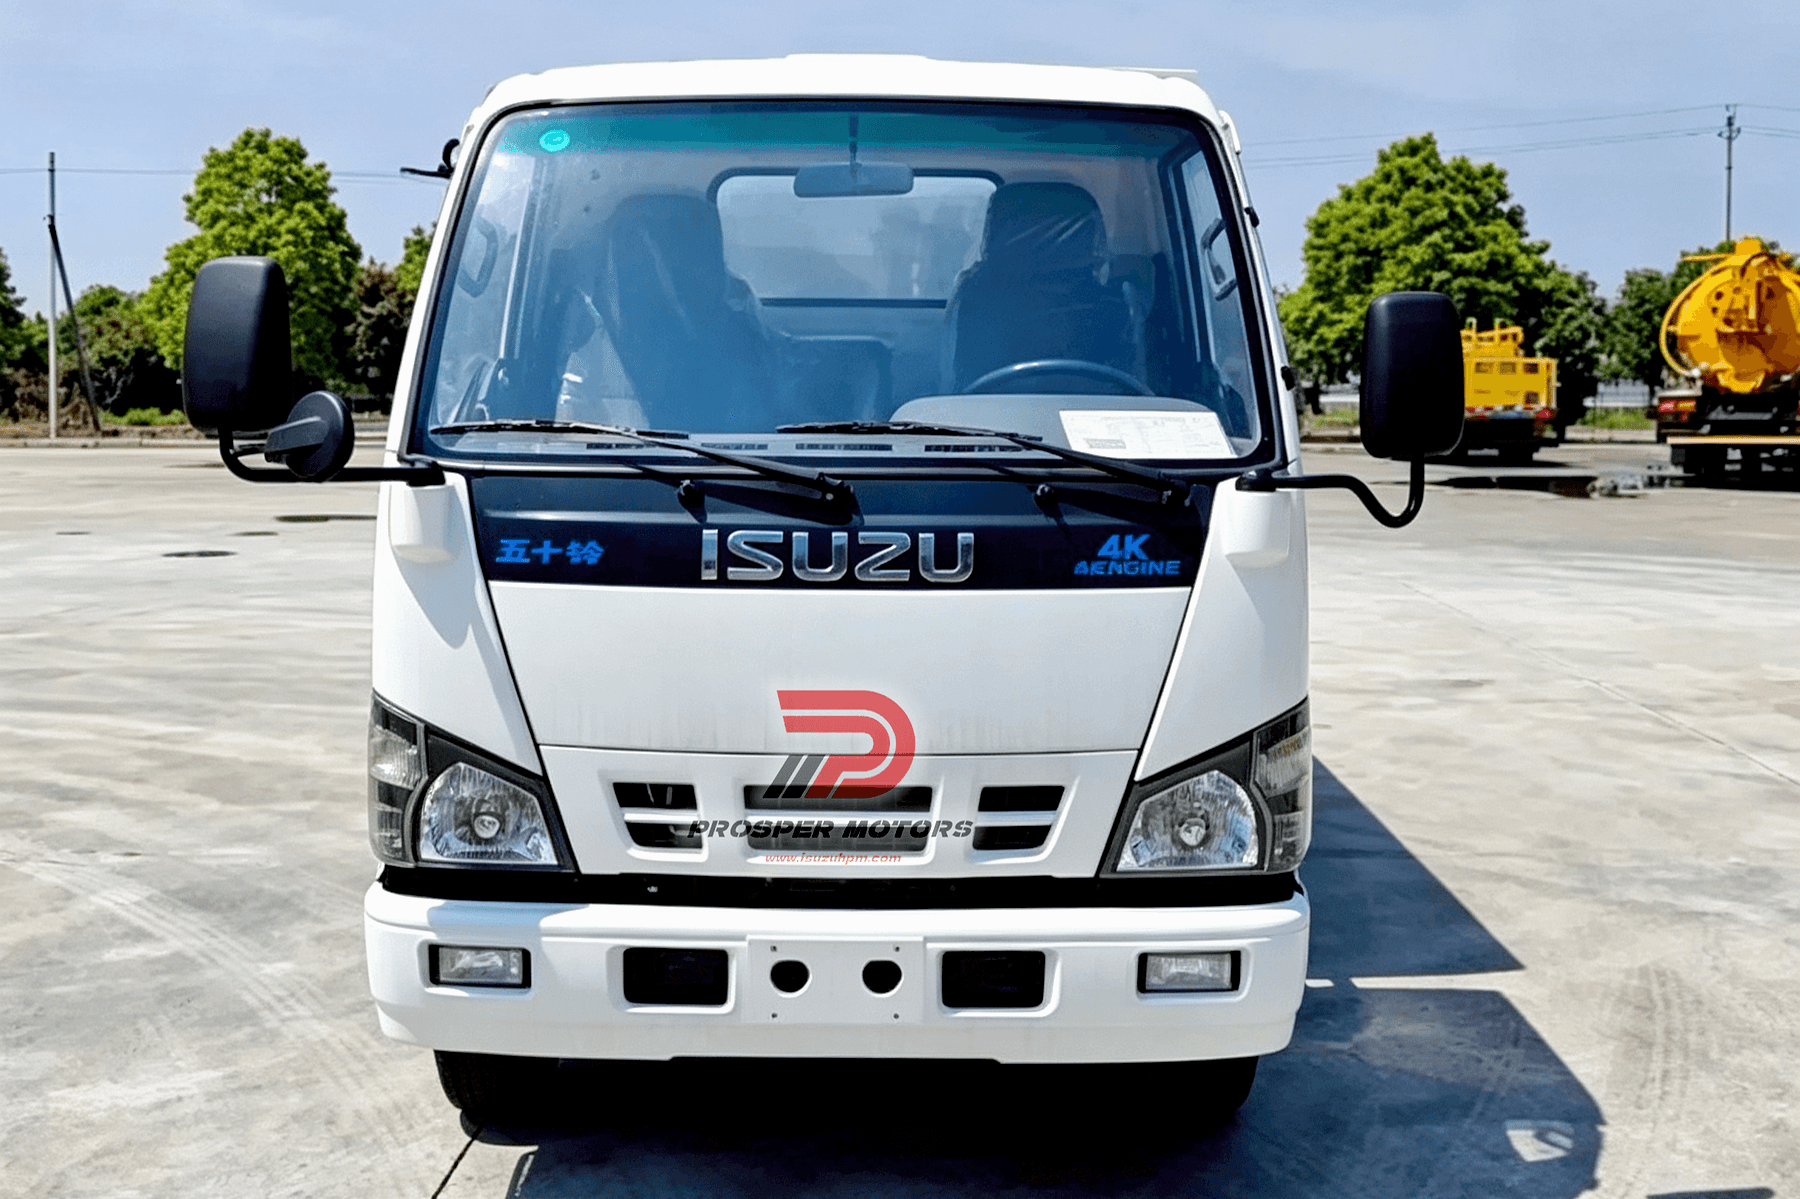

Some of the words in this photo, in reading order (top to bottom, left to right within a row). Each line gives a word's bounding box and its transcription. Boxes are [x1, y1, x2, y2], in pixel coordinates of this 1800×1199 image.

[495, 539, 604, 565] 五十铃
[702, 529, 974, 582] ISUZU
[1097, 534, 1151, 560] 4K
